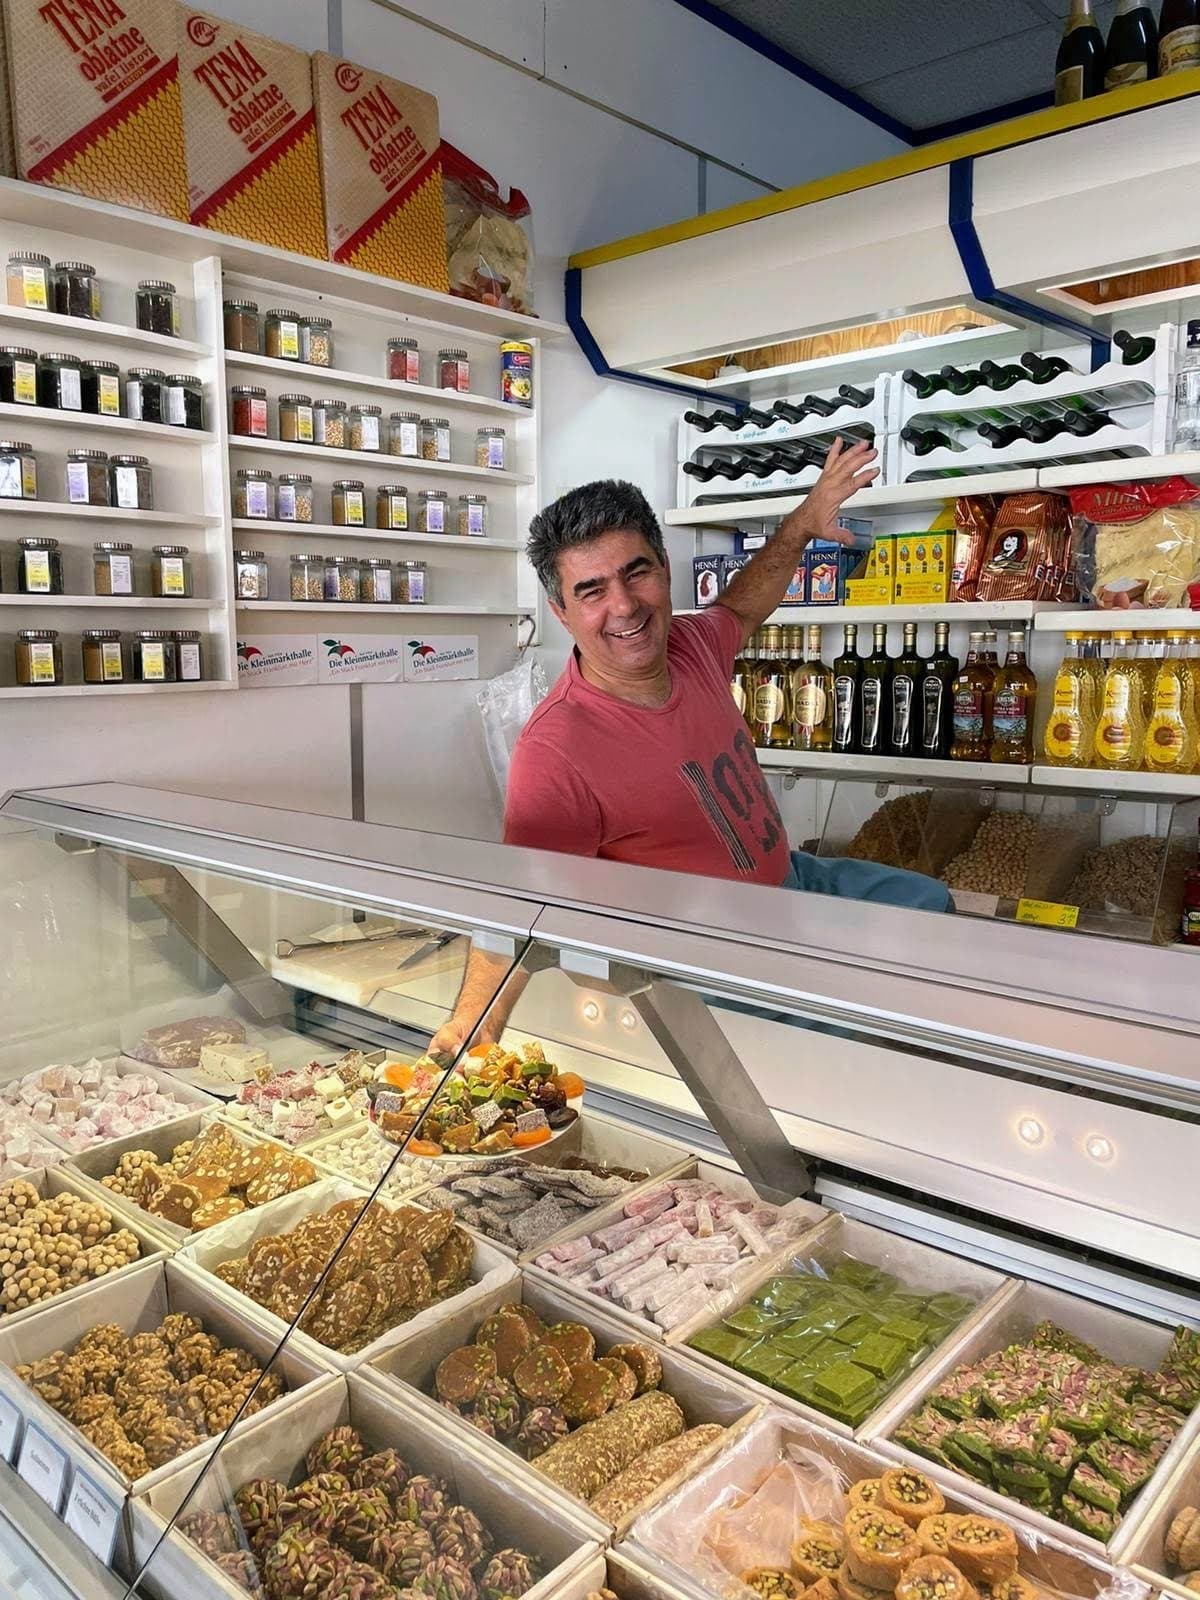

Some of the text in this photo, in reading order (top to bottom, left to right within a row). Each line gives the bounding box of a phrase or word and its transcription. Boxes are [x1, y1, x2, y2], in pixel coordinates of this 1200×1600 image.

[38, 0, 127, 53] TENA
[80, 26, 145, 81] oblatne
[95, 44, 155, 92] vafel listovi
[193, 40, 268, 109] TENA
[228, 83, 284, 134] oblatne
[241, 99, 292, 145] vafel listovi
[340, 84, 403, 151] TENA
[369, 125, 417, 174] oblatne
[380, 163, 400, 184] vafel
[398, 140, 424, 166] listovi
[694, 557, 719, 570] HENNÉ
[724, 559, 746, 569] HENN
[811, 550, 838, 561] HENNÉ
[250, 648, 312, 669] Kleinmarkthalle
[329, 648, 398, 668] Die Kleinmarkthalle
[413, 647, 474, 668] Die Kleinmarkthalle
